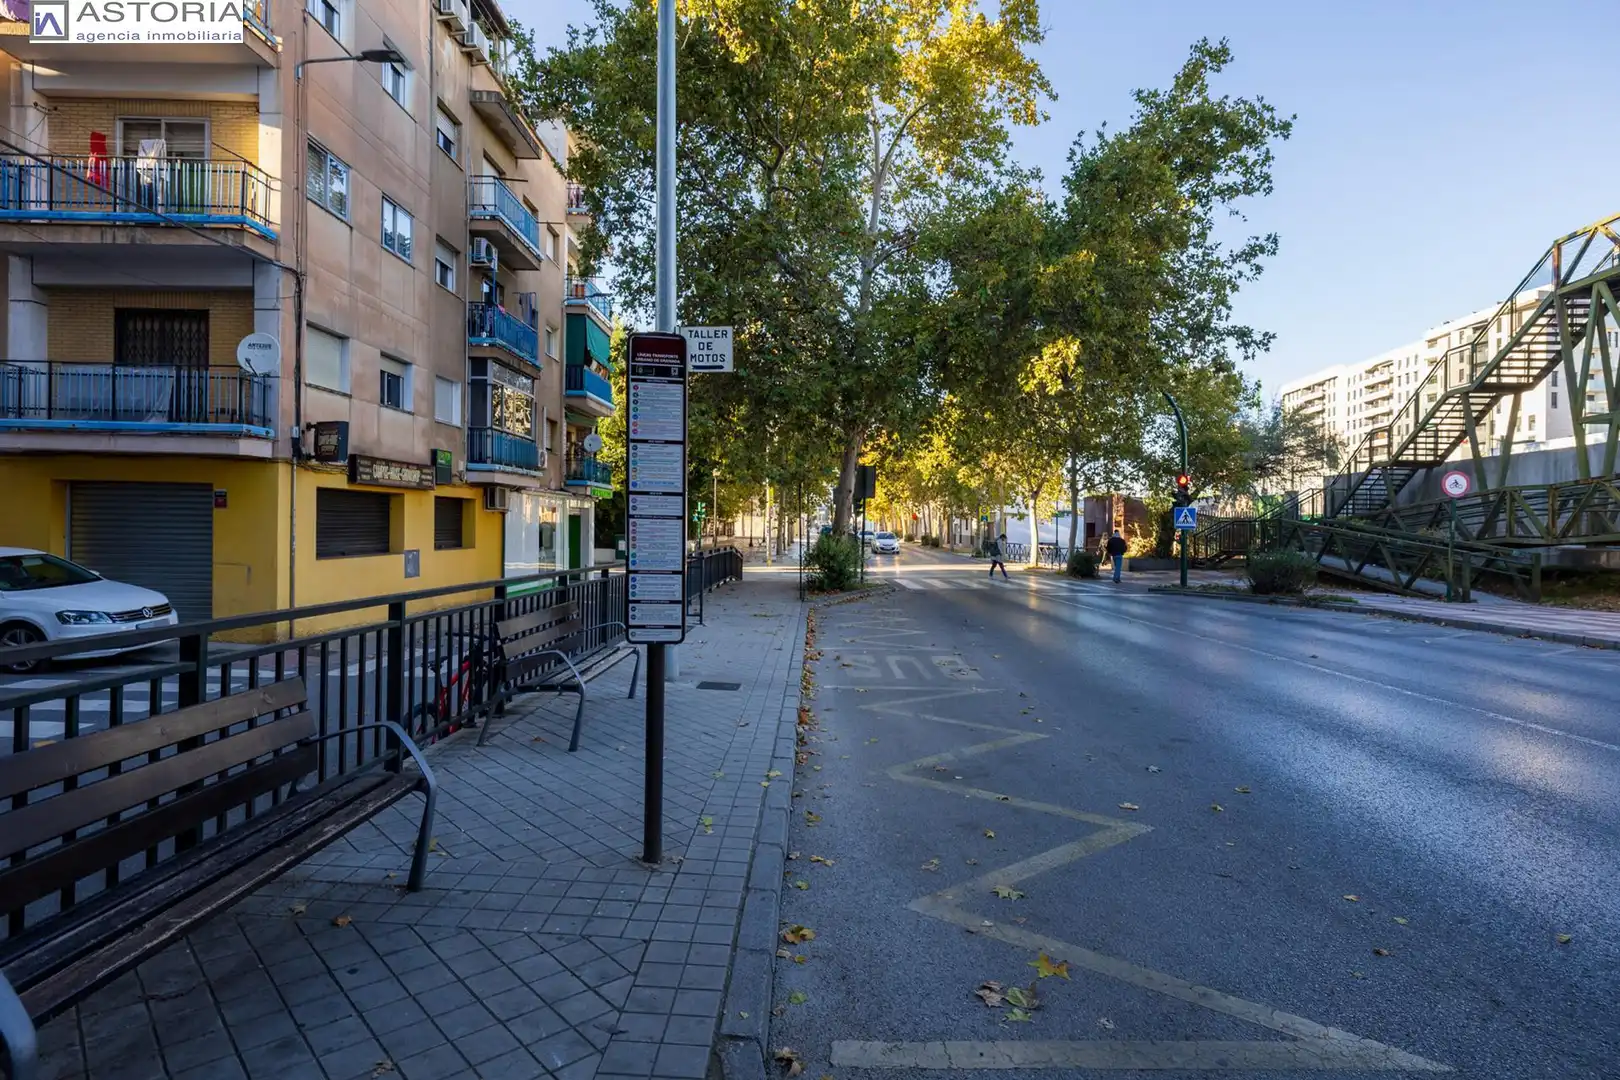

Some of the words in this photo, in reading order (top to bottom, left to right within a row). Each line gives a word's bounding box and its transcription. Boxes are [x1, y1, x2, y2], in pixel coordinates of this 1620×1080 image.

[688, 329, 728, 339] TALLER
[698, 341, 713, 351] DE
[690, 353, 726, 363] MOTOS
[841, 655, 984, 680] BUS
